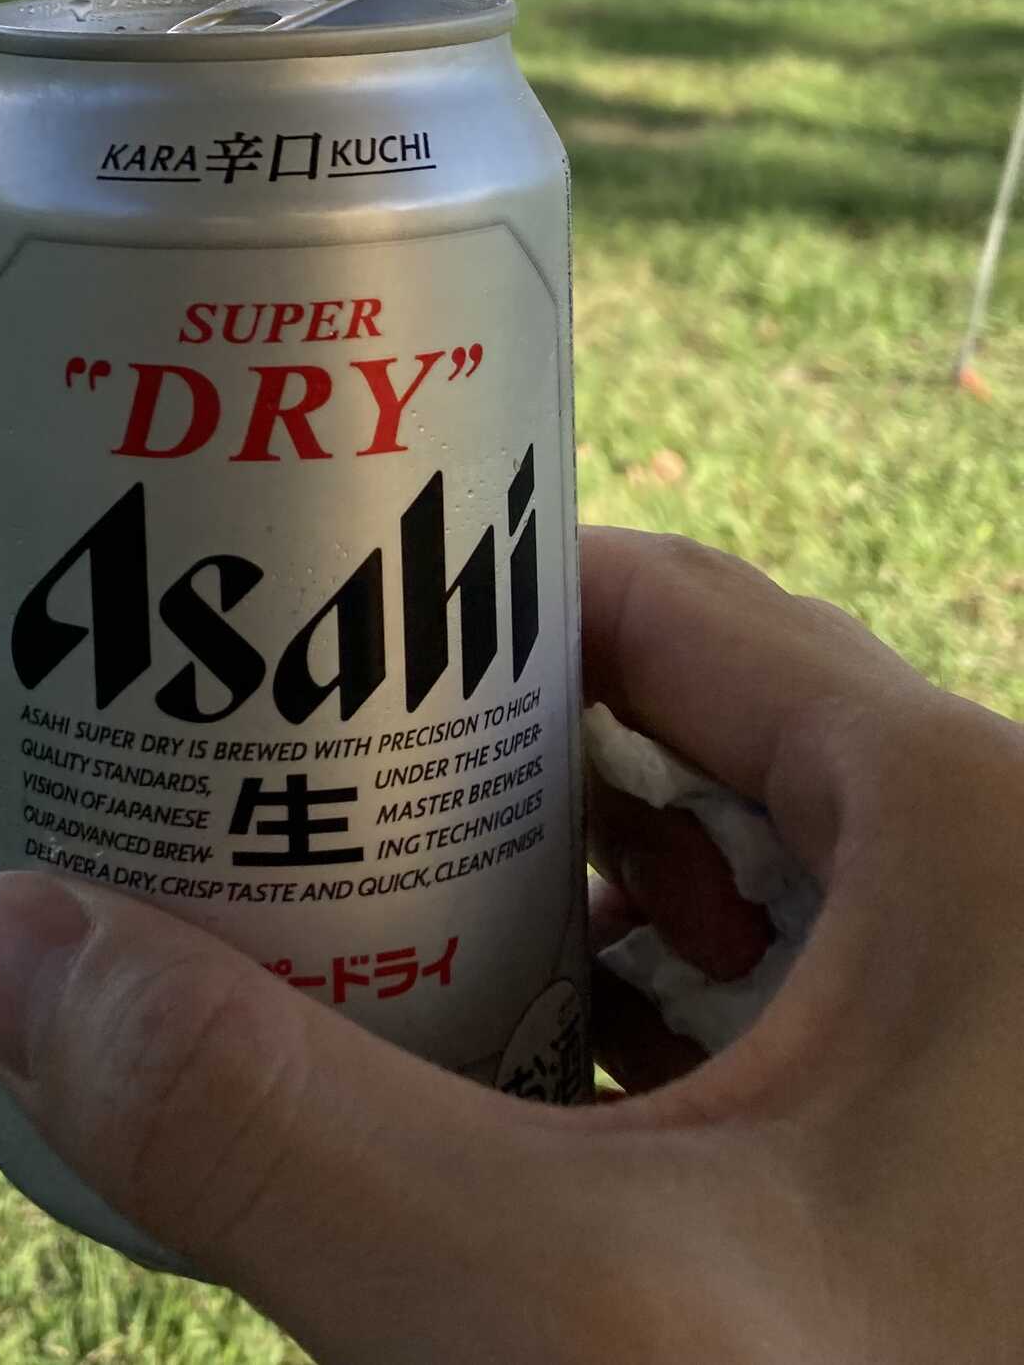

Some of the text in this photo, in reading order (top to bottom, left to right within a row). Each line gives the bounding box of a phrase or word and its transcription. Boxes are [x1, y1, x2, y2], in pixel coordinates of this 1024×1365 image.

[101, 131, 431, 184] KARA 辛口 KUCHI
[178, 297, 383, 345] SUPER
[11, 442, 540, 725] Asahi
[21, 687, 541, 762] ASAHI SUPER DRY IS BREWED WITH PRECISION TO HIGH
[21, 723, 543, 797] QUALITY STANDARDS, UNDER THE SUPER-
[23, 770, 77, 805] VISION
[81, 790, 107, 811] OF
[105, 797, 211, 829] JAPANESE
[376, 788, 464, 825] MASTER
[24, 788, 543, 864] OUR ADVANCED BREW- ING TECHNIQUES
[228, 774, 364, 867] 生
[25, 837, 96, 877] DELIVER
[96, 863, 111, 881] A
[113, 867, 157, 894] DRY,
[160, 876, 223, 899] CRISP
[227, 882, 298, 902] TASTE
[300, 880, 353, 902] AND
[358, 866, 431, 896] QUICK,
[435, 847, 498, 883] CLEAN
